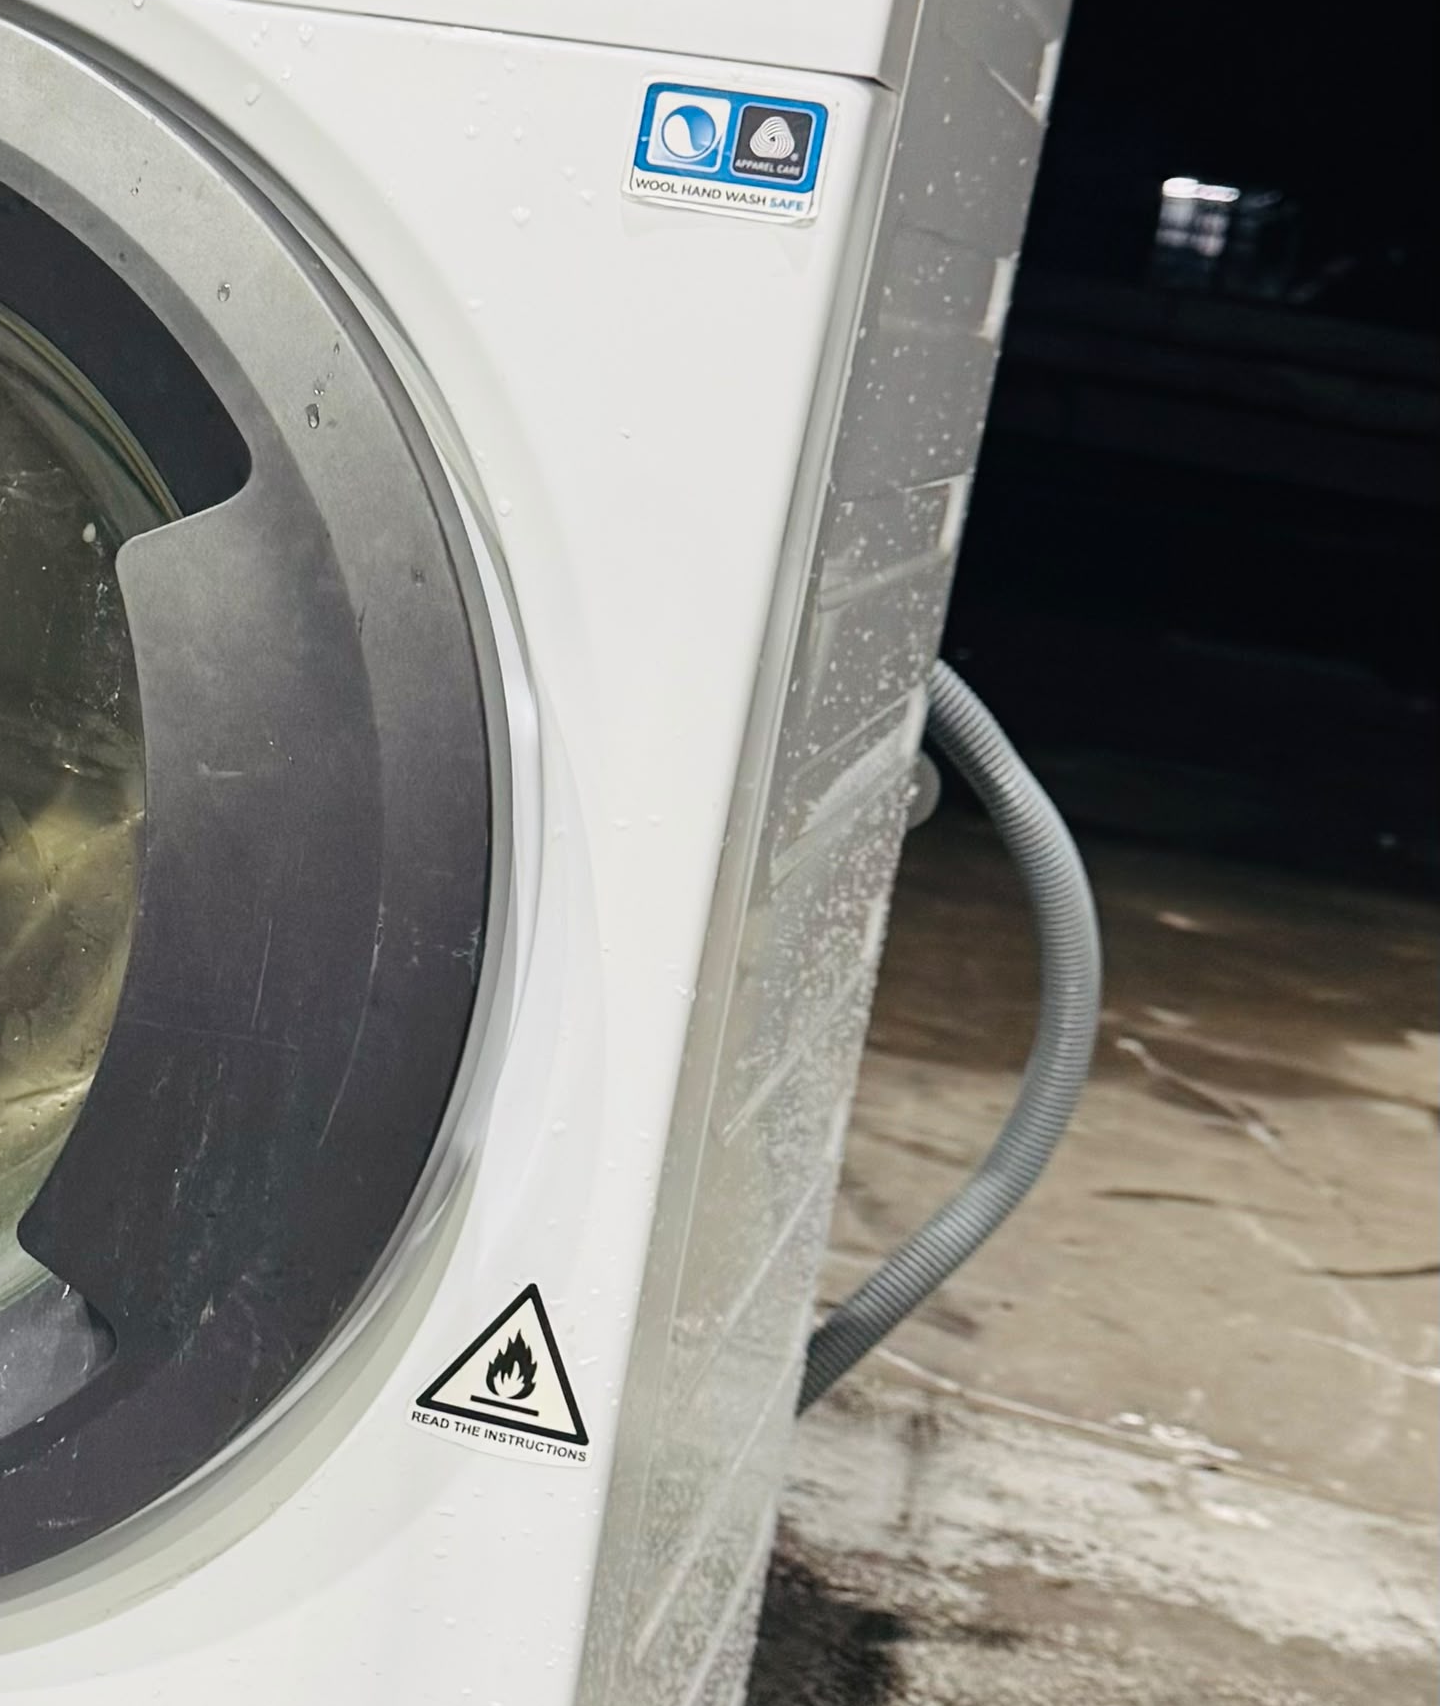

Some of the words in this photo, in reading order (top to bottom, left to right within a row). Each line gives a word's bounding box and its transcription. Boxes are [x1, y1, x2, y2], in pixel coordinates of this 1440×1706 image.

[734, 158, 776, 174] APPAREL
[777, 164, 801, 177] CARE
[636, 177, 678, 194] WOOL
[681, 181, 722, 199] HAND
[726, 188, 767, 206] WASH
[769, 197, 804, 212] SAFE
[411, 1410, 449, 1430] READ
[454, 1420, 480, 1437] THE
[484, 1428, 587, 1462] INSTRUCTIONS
